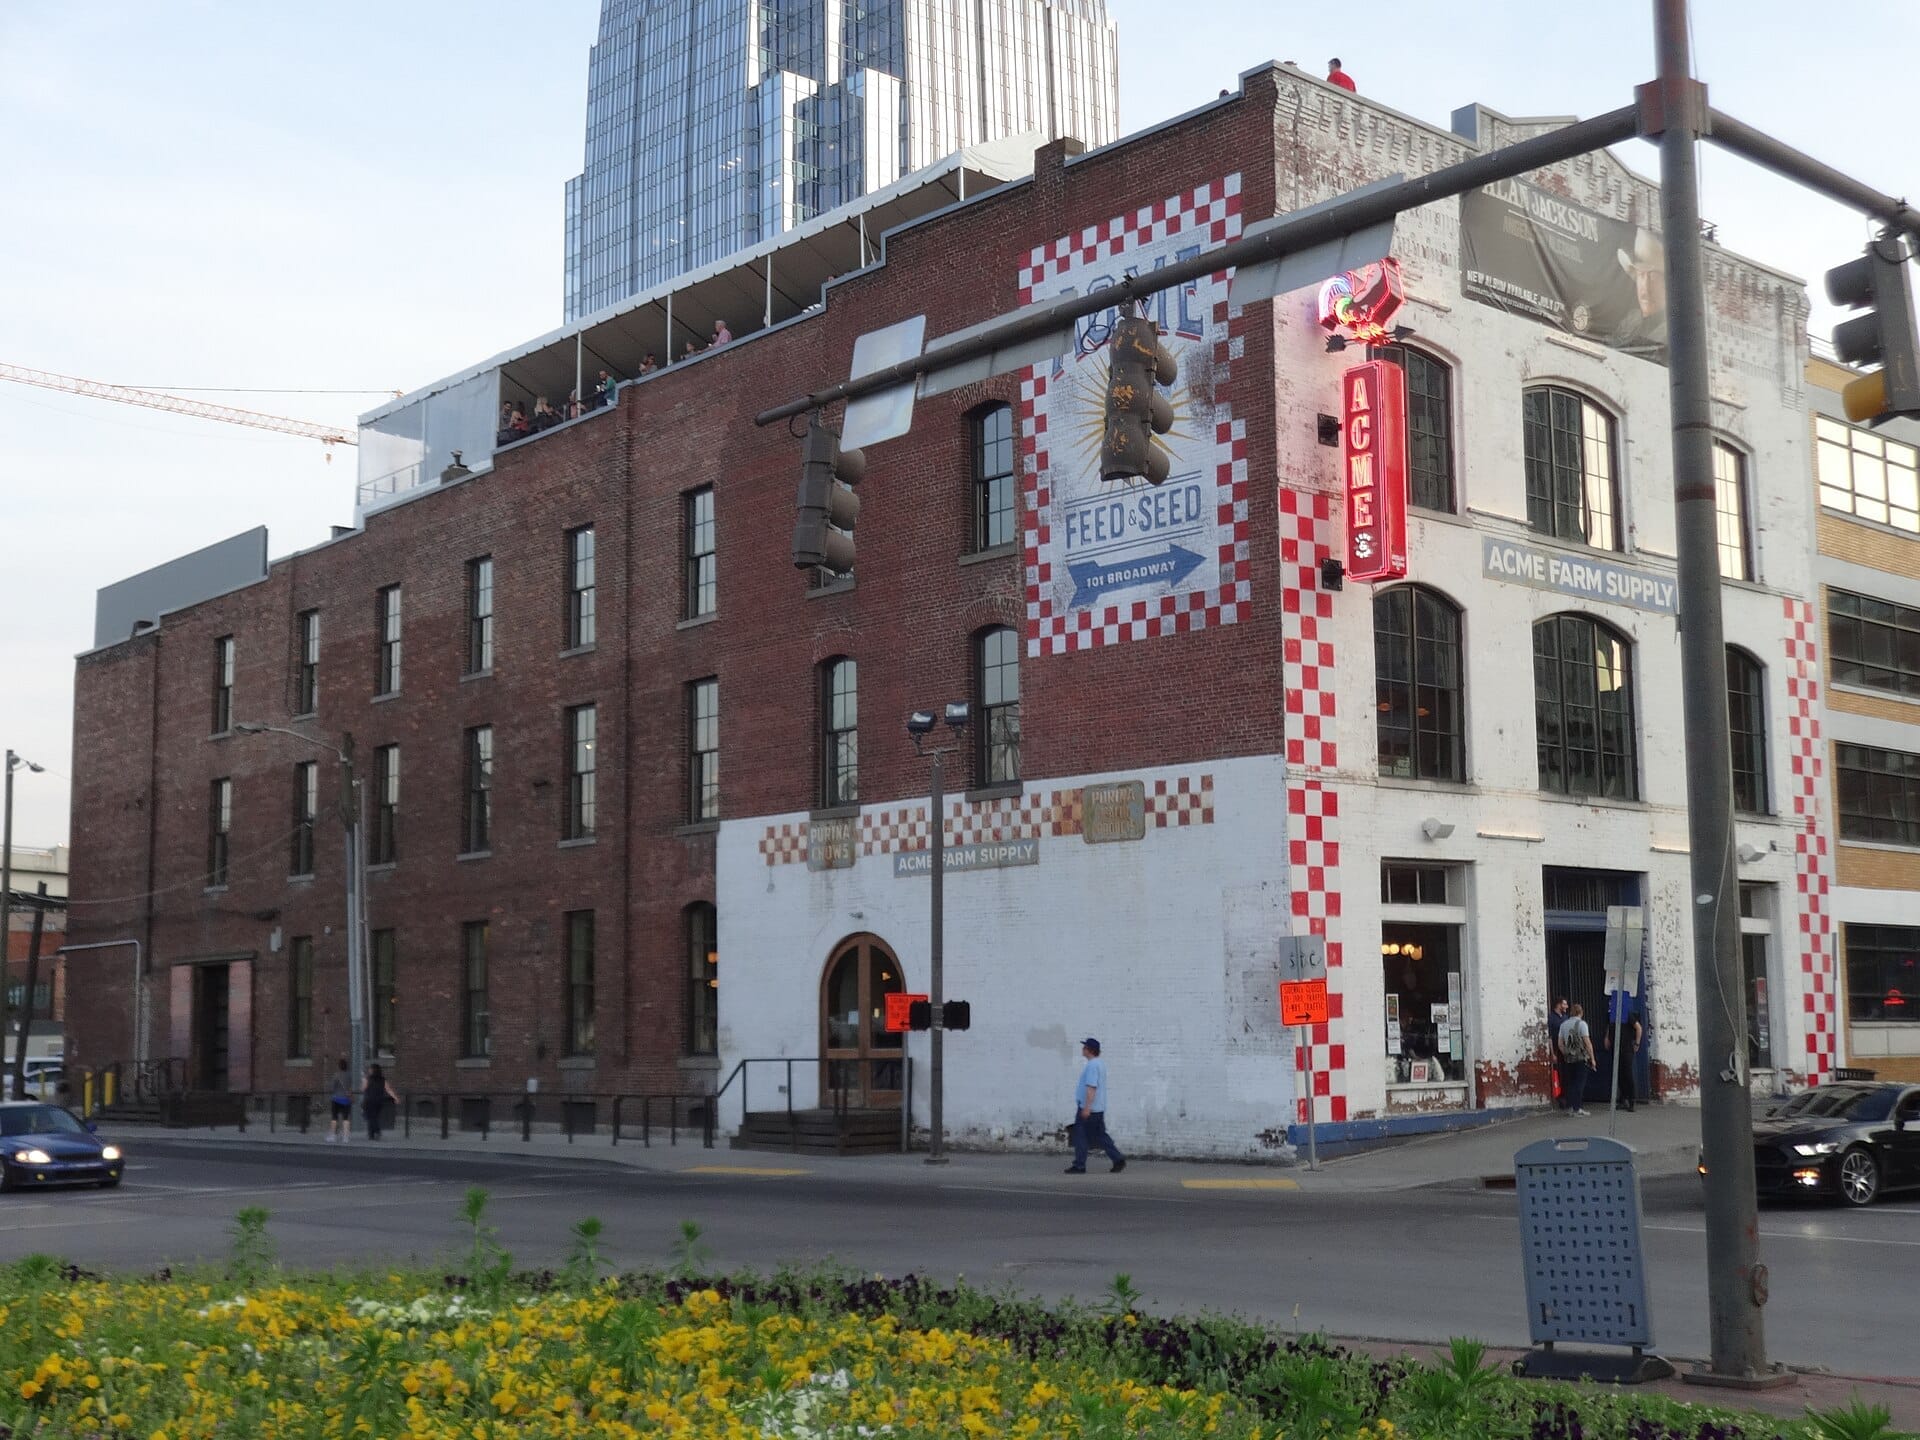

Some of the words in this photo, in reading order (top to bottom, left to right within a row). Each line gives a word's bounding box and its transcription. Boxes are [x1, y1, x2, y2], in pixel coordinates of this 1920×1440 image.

[1531, 191, 1598, 243] JACKSON
[1467, 269, 1485, 285] NEW
[1052, 244, 1203, 382] CME
[1350, 377, 1374, 528] ACME
[1065, 502, 1125, 549] FEED
[1128, 508, 1137, 527] &
[1138, 484, 1201, 532] SEED
[1086, 576, 1105, 589] 101
[1107, 560, 1176, 585] BROADWAY
[1488, 546, 1546, 581] ACME
[1550, 560, 1603, 593] FARM
[1606, 571, 1674, 607] SUPPLY
[810, 823, 850, 843] PURINA
[899, 854, 932, 871] ACME
[980, 844, 1034, 863] SUPPLY
